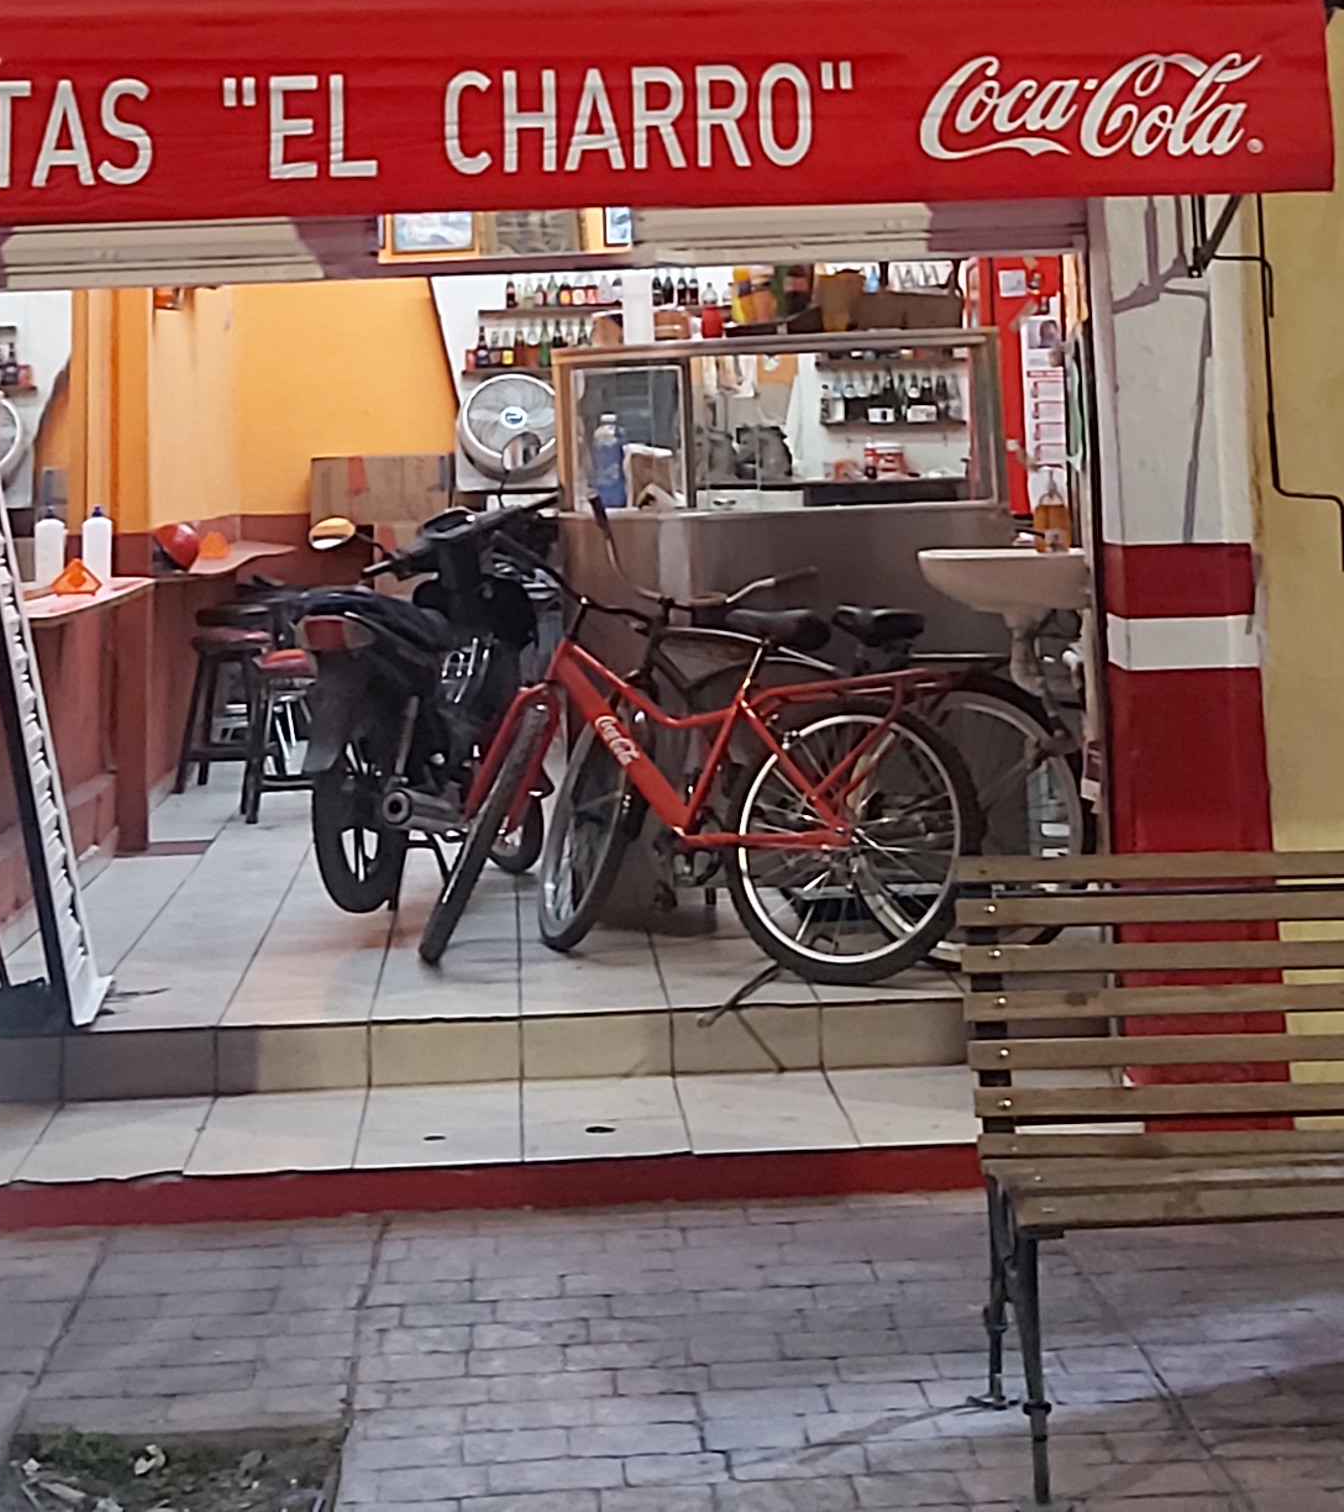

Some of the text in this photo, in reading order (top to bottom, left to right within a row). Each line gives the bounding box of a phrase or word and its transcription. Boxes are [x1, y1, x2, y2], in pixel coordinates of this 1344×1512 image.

[222, 73, 379, 181] "EL
[442, 59, 855, 176] CHARRO"
[919, 52, 1264, 161] Coca-Cola
